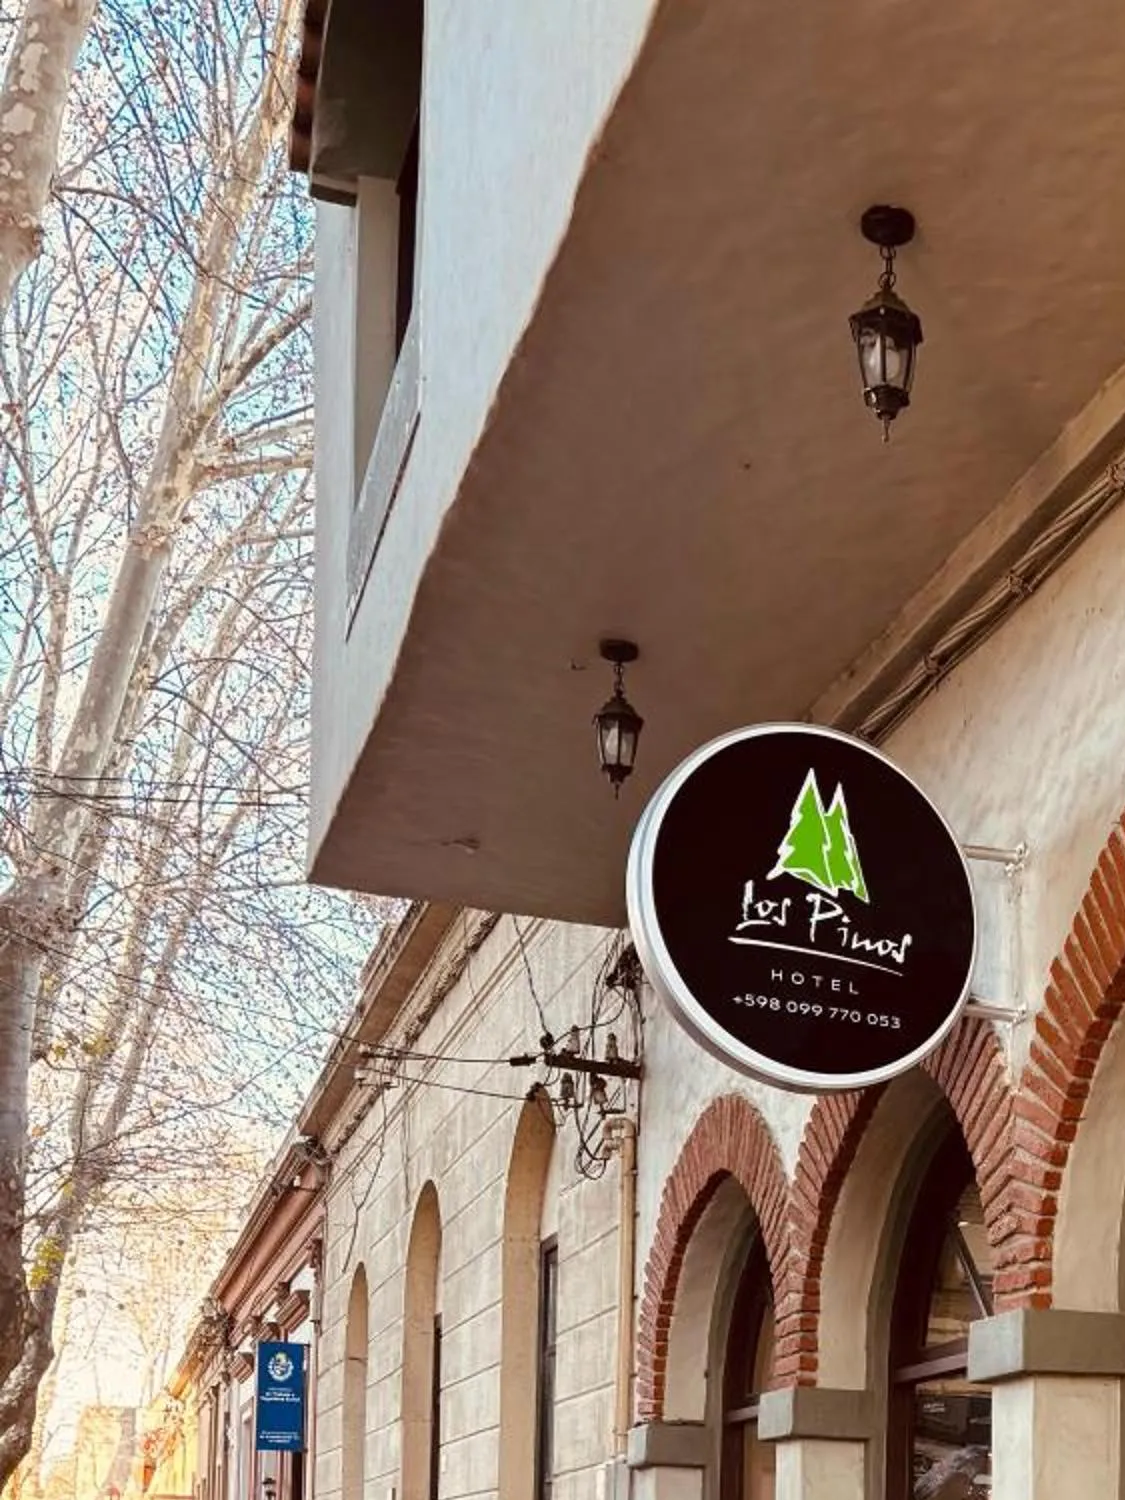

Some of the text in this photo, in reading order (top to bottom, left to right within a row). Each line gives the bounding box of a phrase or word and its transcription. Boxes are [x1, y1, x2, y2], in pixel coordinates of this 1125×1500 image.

[736, 880, 912, 963] Los Pinos
[771, 969, 860, 995] HOTEL
[733, 993, 901, 1029] +598 099 770 053
